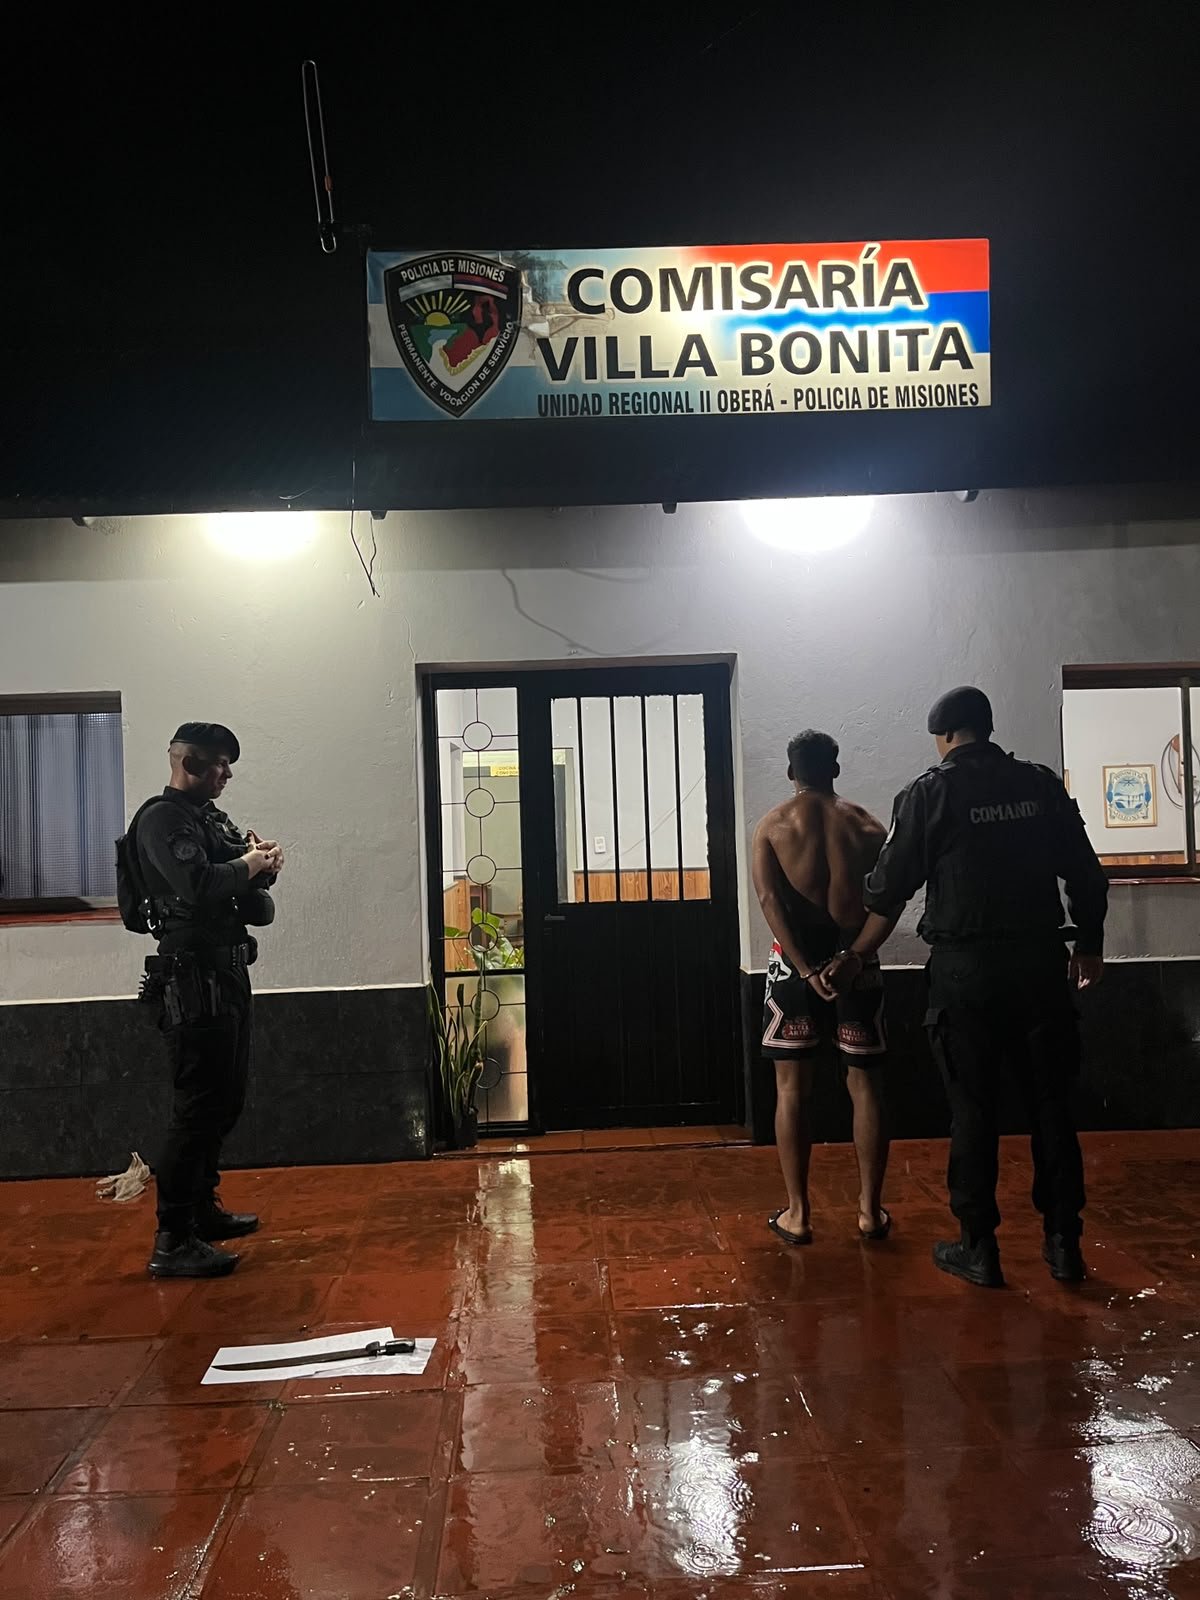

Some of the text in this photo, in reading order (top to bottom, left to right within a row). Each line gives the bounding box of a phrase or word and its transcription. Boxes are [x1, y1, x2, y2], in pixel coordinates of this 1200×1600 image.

[400, 259, 505, 283] POLICIA DE MISIONES
[567, 246, 924, 315] COMISARÍA
[397, 320, 515, 407] PERMANENTE VOCACION DE SERVICIO
[536, 326, 975, 381] VILLA BONITA
[537, 393, 603, 417] UNIDAD
[608, 390, 694, 416] REGIONAL
[700, 390, 711, 413] II
[717, 383, 775, 413] OBERÁ
[794, 387, 865, 410] POLICIA
[868, 386, 889, 408] DE
[895, 383, 979, 407] MISIONES
